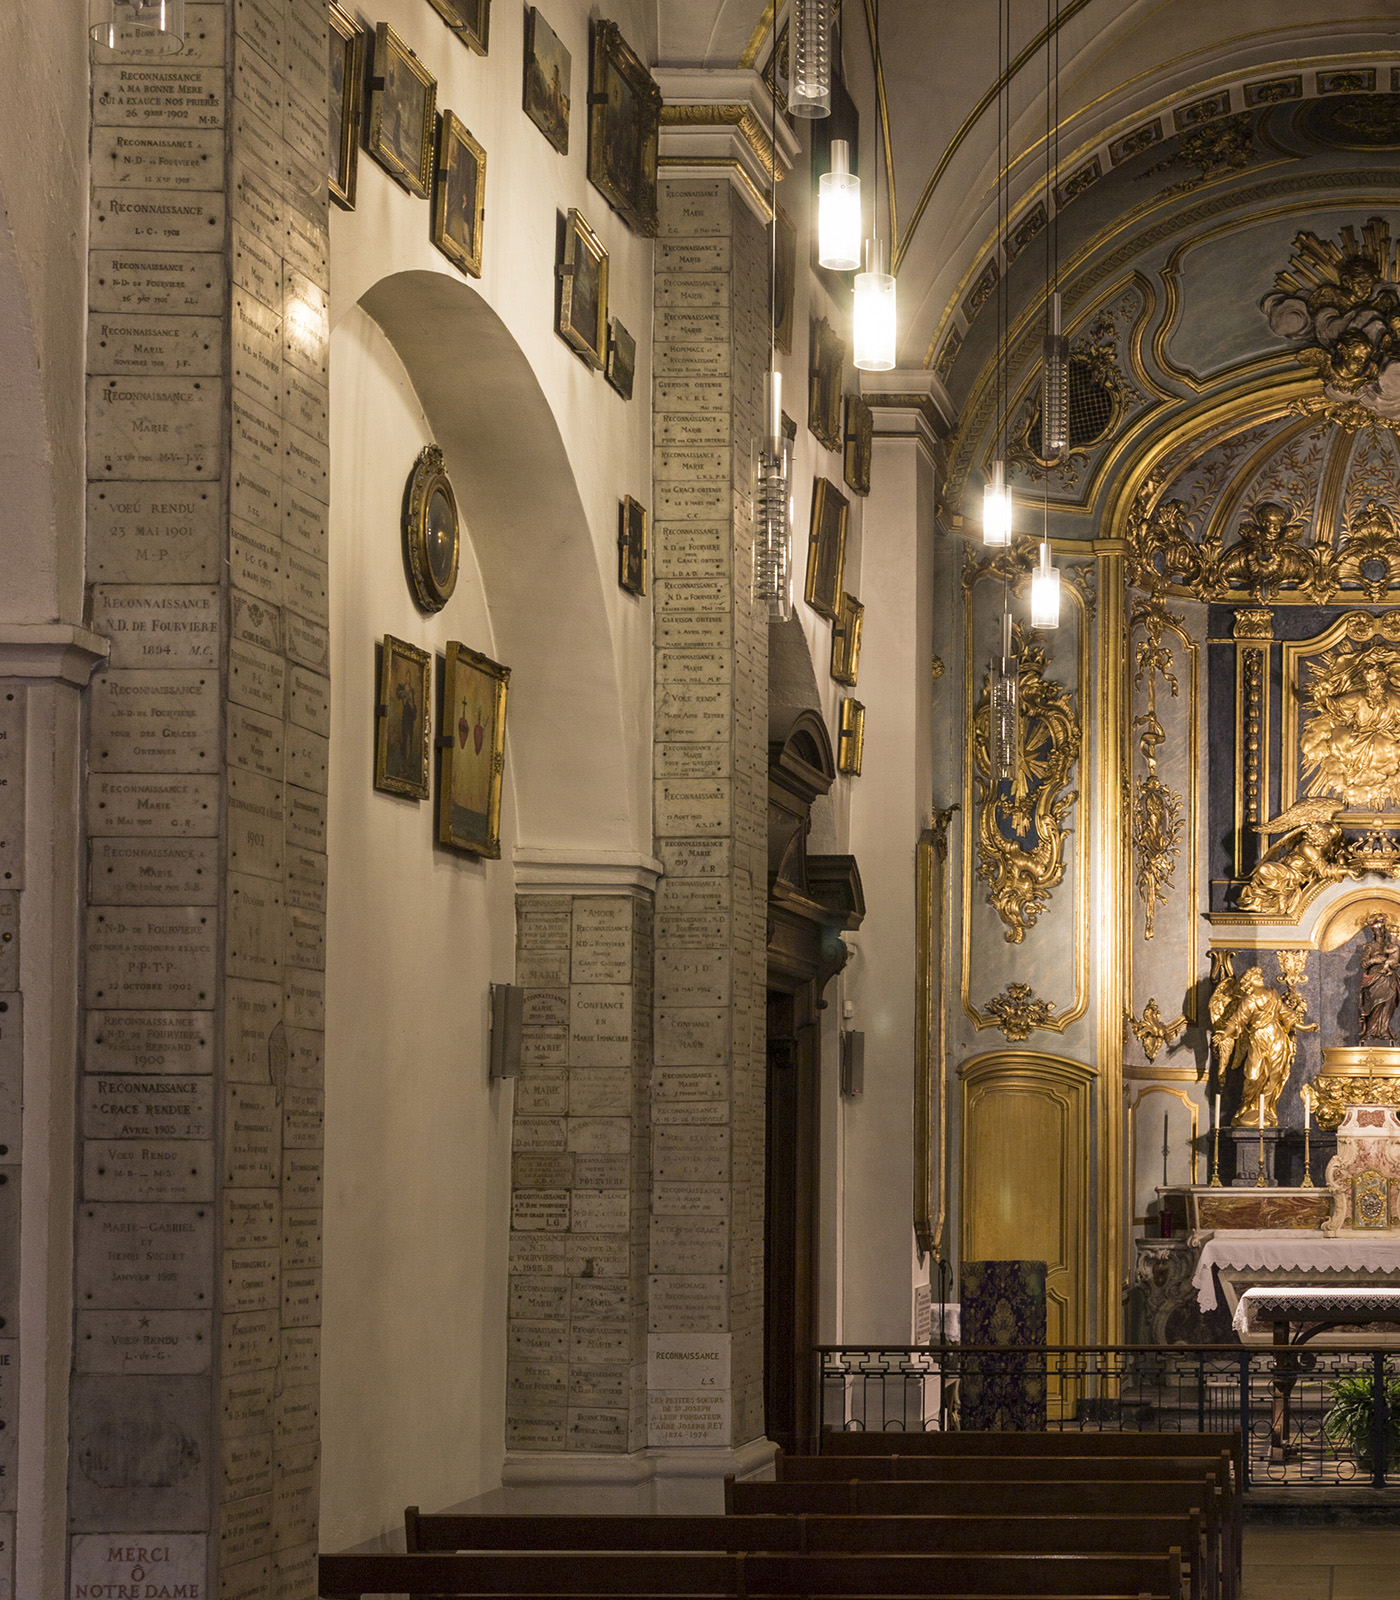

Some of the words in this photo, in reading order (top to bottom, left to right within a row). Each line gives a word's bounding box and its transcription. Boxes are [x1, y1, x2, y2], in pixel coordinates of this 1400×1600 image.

[120, 71, 202, 81] RECONNAISSANCE
[144, 86, 175, 94] BONNE
[99, 97, 115, 105] QUI
[126, 97, 161, 106] EXAUCE
[165, 98, 183, 106] NOS
[117, 137, 193, 148] RECONNAISSANCE
[110, 200, 203, 215] RECONNAISSANCE
[112, 260, 183, 271] RECONNAISSANCE
[146, 280, 185, 289] FOURVIERE
[664, 313, 720, 321] RECONNAISSANCE
[101, 325, 180, 337] RECONNAISSANCE
[134, 344, 164, 354] MARIE
[103, 389, 193, 404] RECONNAISSANCE
[132, 421, 169, 434] MARIE
[151, 504, 195, 514] RENDU
[135, 526, 159, 536] MAI
[166, 526, 193, 538] 1901
[663, 527, 720, 536] RECONNAISSANCE
[103, 596, 209, 609] RECONNAISSANCE
[132, 621, 146, 631] DE
[152, 620, 218, 632] FOURVIERE
[109, 682, 202, 697] RECONNAISSANCE
[151, 708, 196, 719] FOURVIERE
[101, 783, 189, 794] RECONNAISSANCE
[664, 792, 724, 801] RECONNAISSANCE
[137, 799, 171, 810] MARIE
[103, 845, 195, 859] RECONNAISSANCE
[688, 849, 712, 857] MARIE
[139, 866, 173, 878] MARIE
[587, 909, 615, 918] AMOUR
[148, 924, 202, 935] FOURVIERE
[577, 1001, 624, 1010] CONFIANCE
[104, 1016, 195, 1027] RECONNAISSANCE
[596, 1018, 606, 1026] EN
[145, 1043, 192, 1052] BERNARD
[134, 1056, 165, 1066] 1900
[98, 1081, 198, 1094] RECONNAISSANCE
[101, 1103, 139, 1115] GRACE
[145, 1104, 191, 1117] RENDUE
[142, 1149, 178, 1161] RENDU
[515, 1193, 567, 1201] RECONNAISSANCE
[656, 1352, 719, 1360] RECONNAISSANCE
[107, 1547, 170, 1564] MERCI
[131, 1563, 145, 1582] Ô
[75, 1584, 140, 1600] NOTRE
[145, 1584, 199, 1599] DAME
